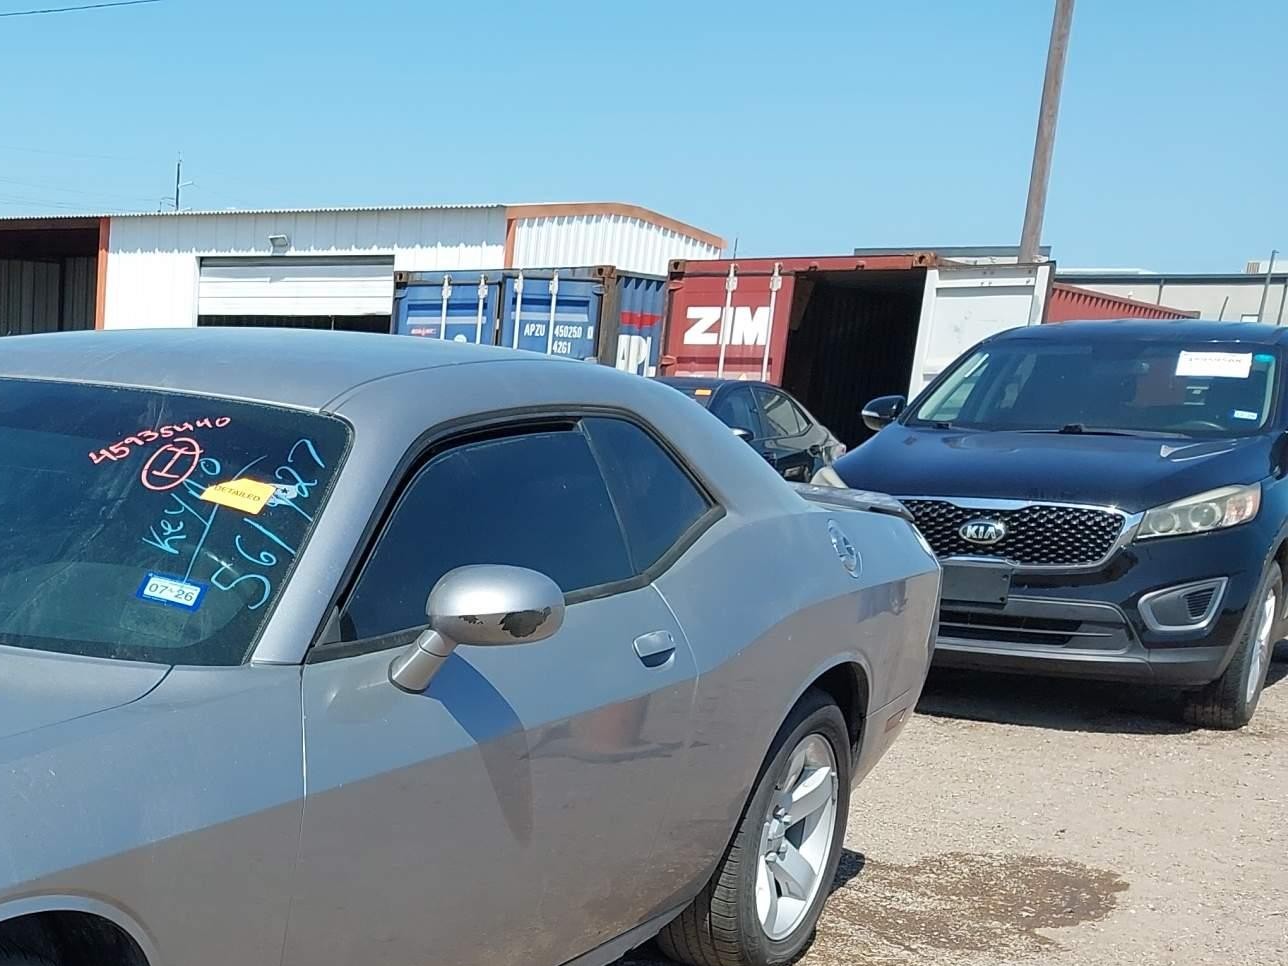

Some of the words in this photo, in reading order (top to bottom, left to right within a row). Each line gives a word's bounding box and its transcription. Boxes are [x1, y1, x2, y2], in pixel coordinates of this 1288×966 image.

[523, 323, 546, 337] APZU
[683, 306, 771, 346] ZIM
[615, 334, 657, 378] APL
[88, 416, 231, 465] 45935440
[214, 485, 261, 502] DETAILED
[966, 525, 997, 540] KIA
